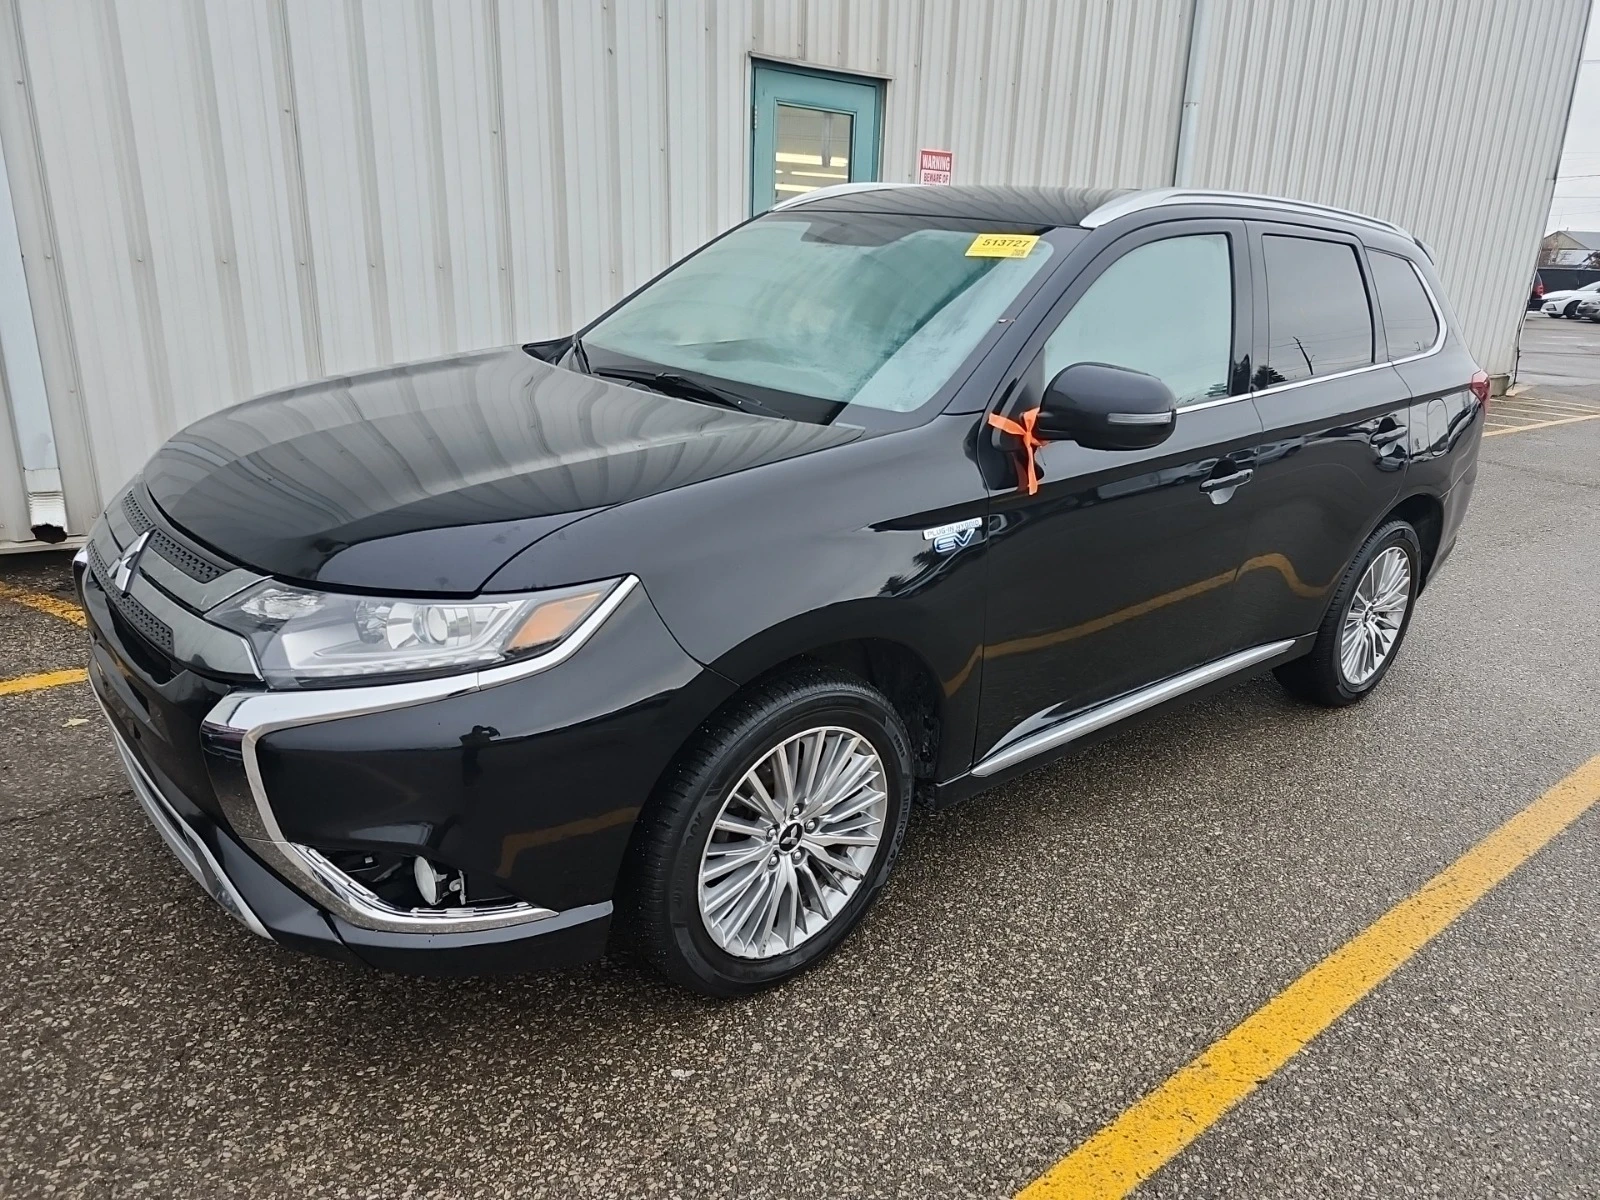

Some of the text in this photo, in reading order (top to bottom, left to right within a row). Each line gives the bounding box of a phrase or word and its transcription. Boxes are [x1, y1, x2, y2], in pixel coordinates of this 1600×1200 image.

[922, 154, 950, 171] WARNING
[924, 172, 949, 183] BEWARE OF
[982, 238, 1031, 248] 513727
[926, 519, 980, 538] PLUG-IN HYBRID
[934, 528, 975, 553] EV
